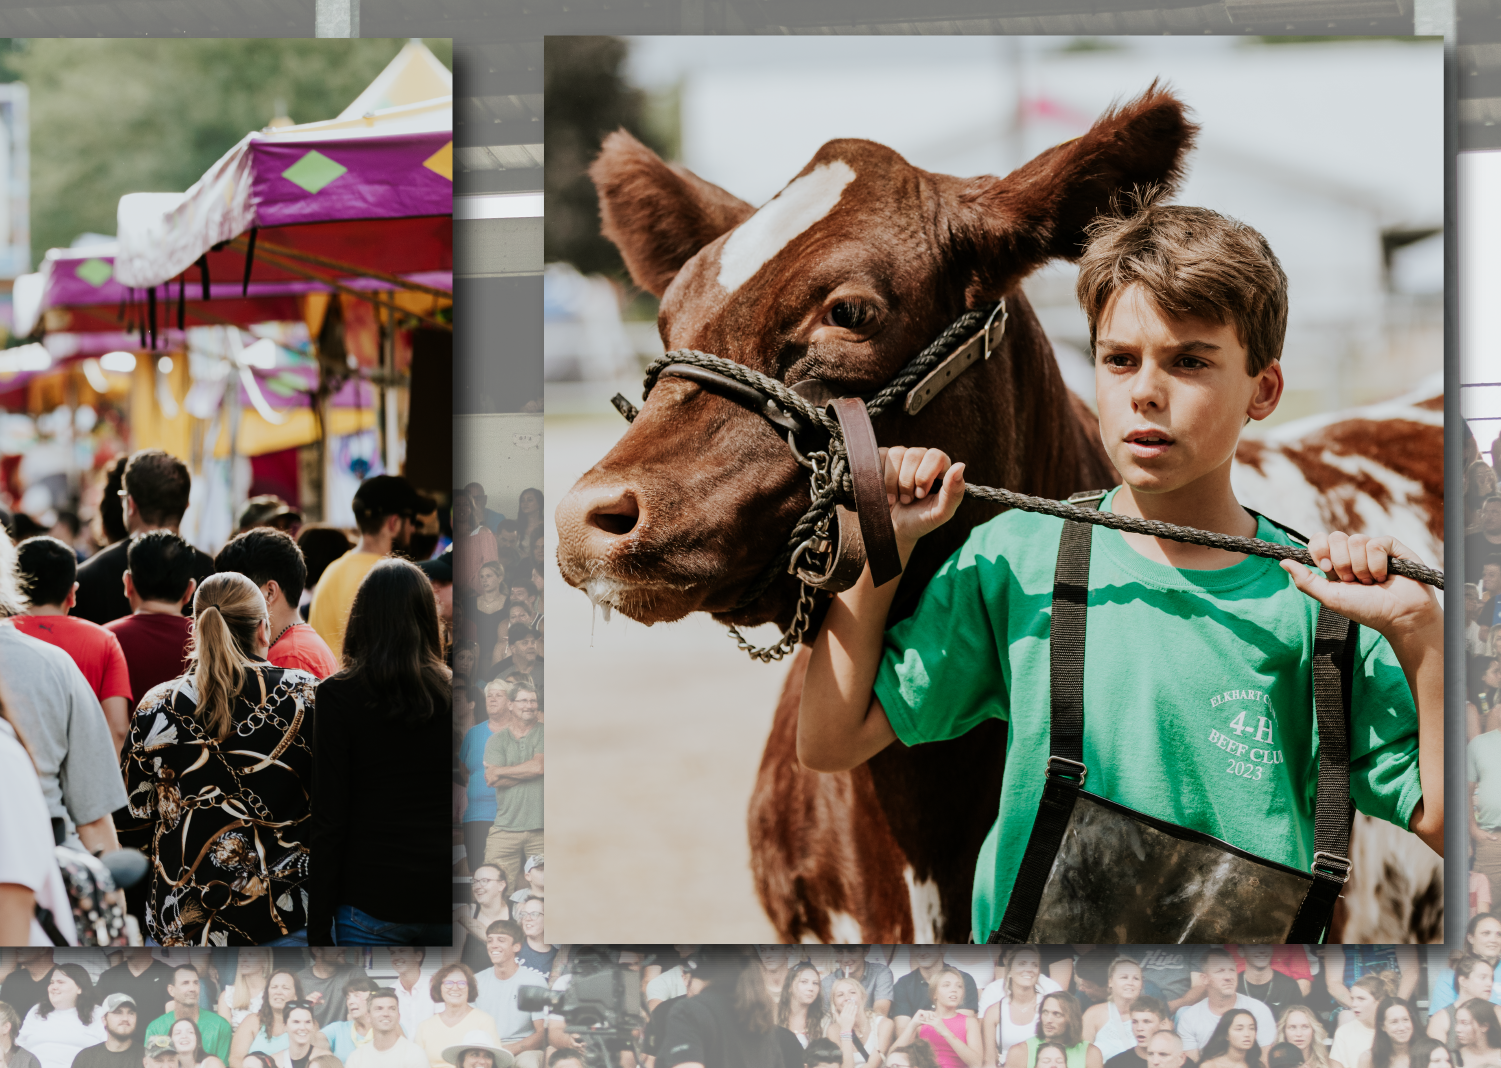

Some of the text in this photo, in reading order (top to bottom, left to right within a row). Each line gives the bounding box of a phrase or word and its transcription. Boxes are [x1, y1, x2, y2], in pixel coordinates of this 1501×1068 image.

[1210, 689, 1263, 708] ELKHART
[1229, 711, 1274, 744] 4-H
[1208, 728, 1284, 764] BEEF CLU
[1226, 759, 1263, 780] 2023
